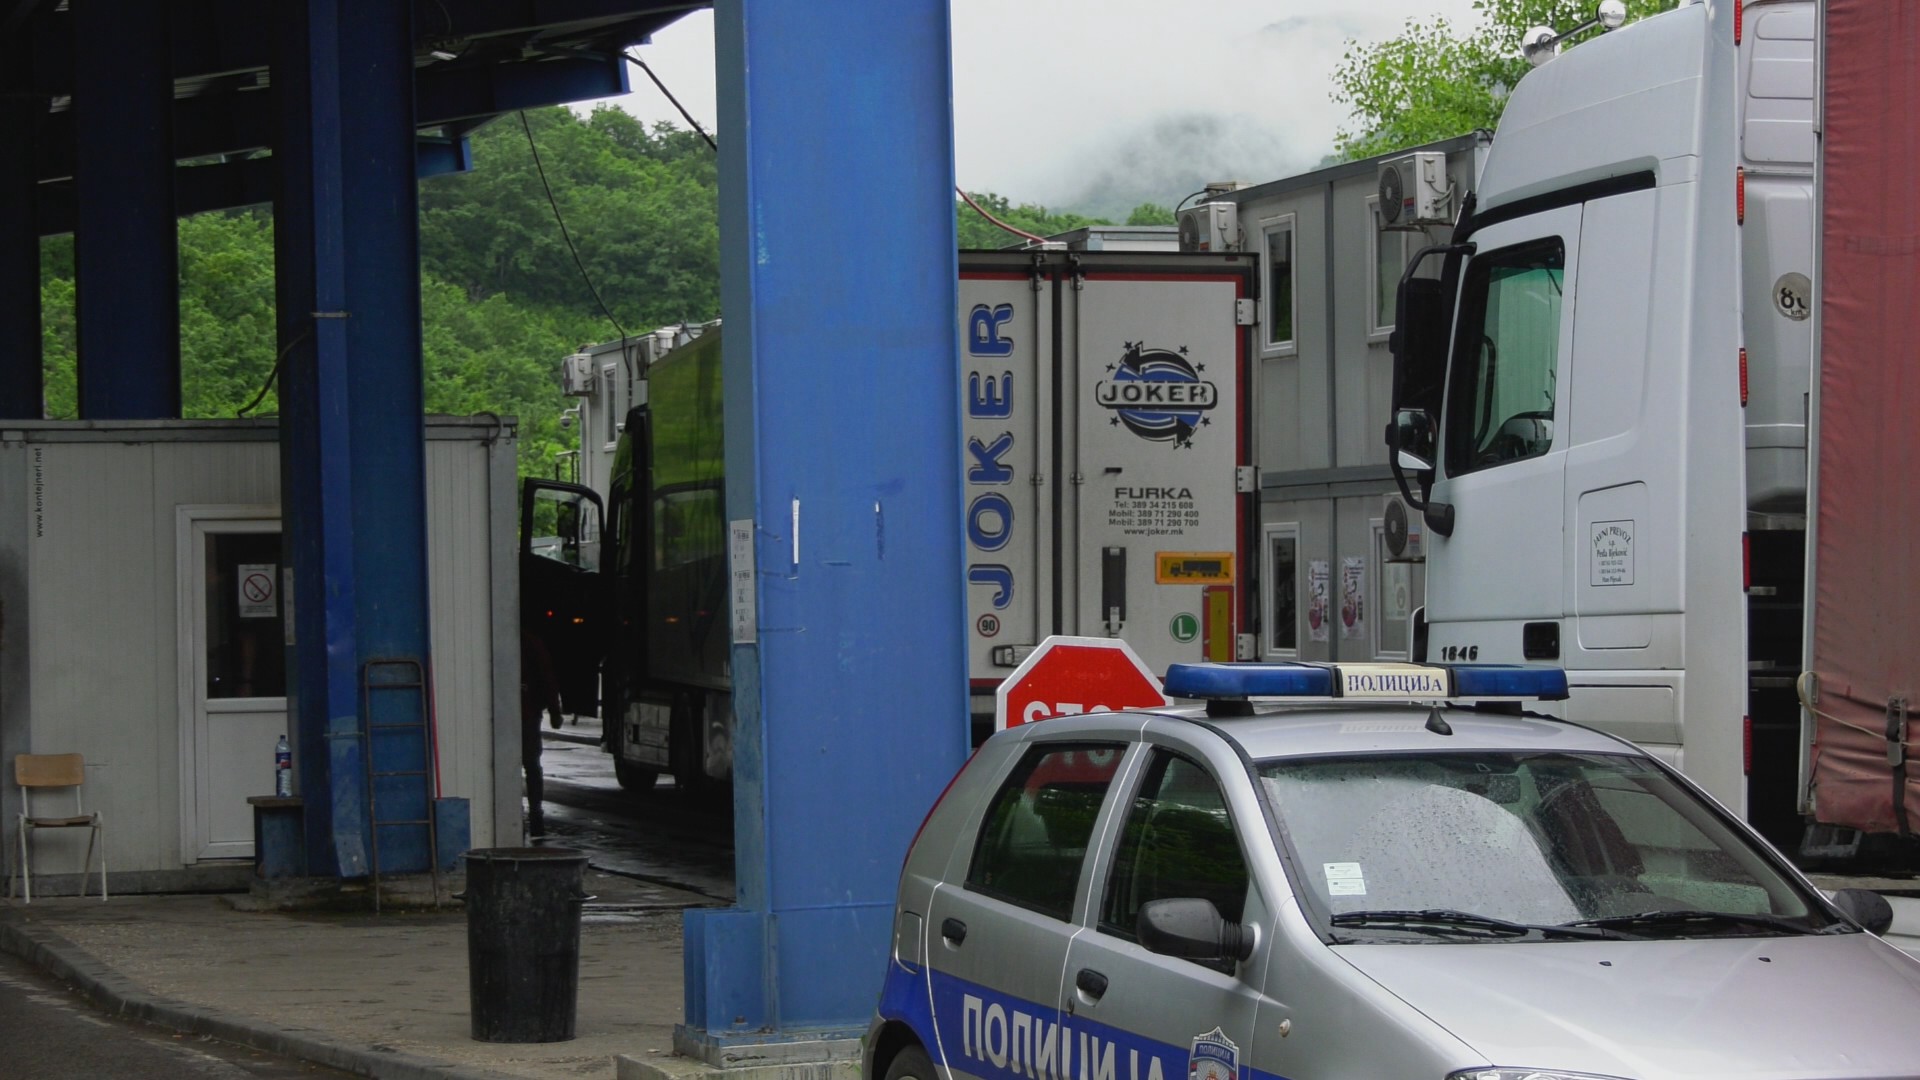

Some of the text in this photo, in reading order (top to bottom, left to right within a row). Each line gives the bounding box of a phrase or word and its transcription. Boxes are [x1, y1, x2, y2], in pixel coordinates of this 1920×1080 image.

[1102, 384, 1207, 403] JOKER
[967, 303, 1014, 610] JOKER
[33, 448, 44, 538] www.kontejneri.net
[1114, 487, 1193, 500] FURKA
[1114, 501, 1129, 509] Tel:
[1132, 501, 1147, 509] 389
[1149, 501, 1159, 509] 34
[1161, 501, 1177, 509] 215
[1108, 509, 1199, 518] Mobil: 389 71 290 400
[1108, 518, 1135, 526] Mobil:
[1167, 519, 1182, 527] 290
[1184, 519, 1199, 527] 700
[1124, 528, 1184, 537] www.joker.mk
[982, 619, 996, 632] 90
[1178, 617, 1192, 638] L
[1347, 674, 1442, 697] ПОЛИЦИЈА
